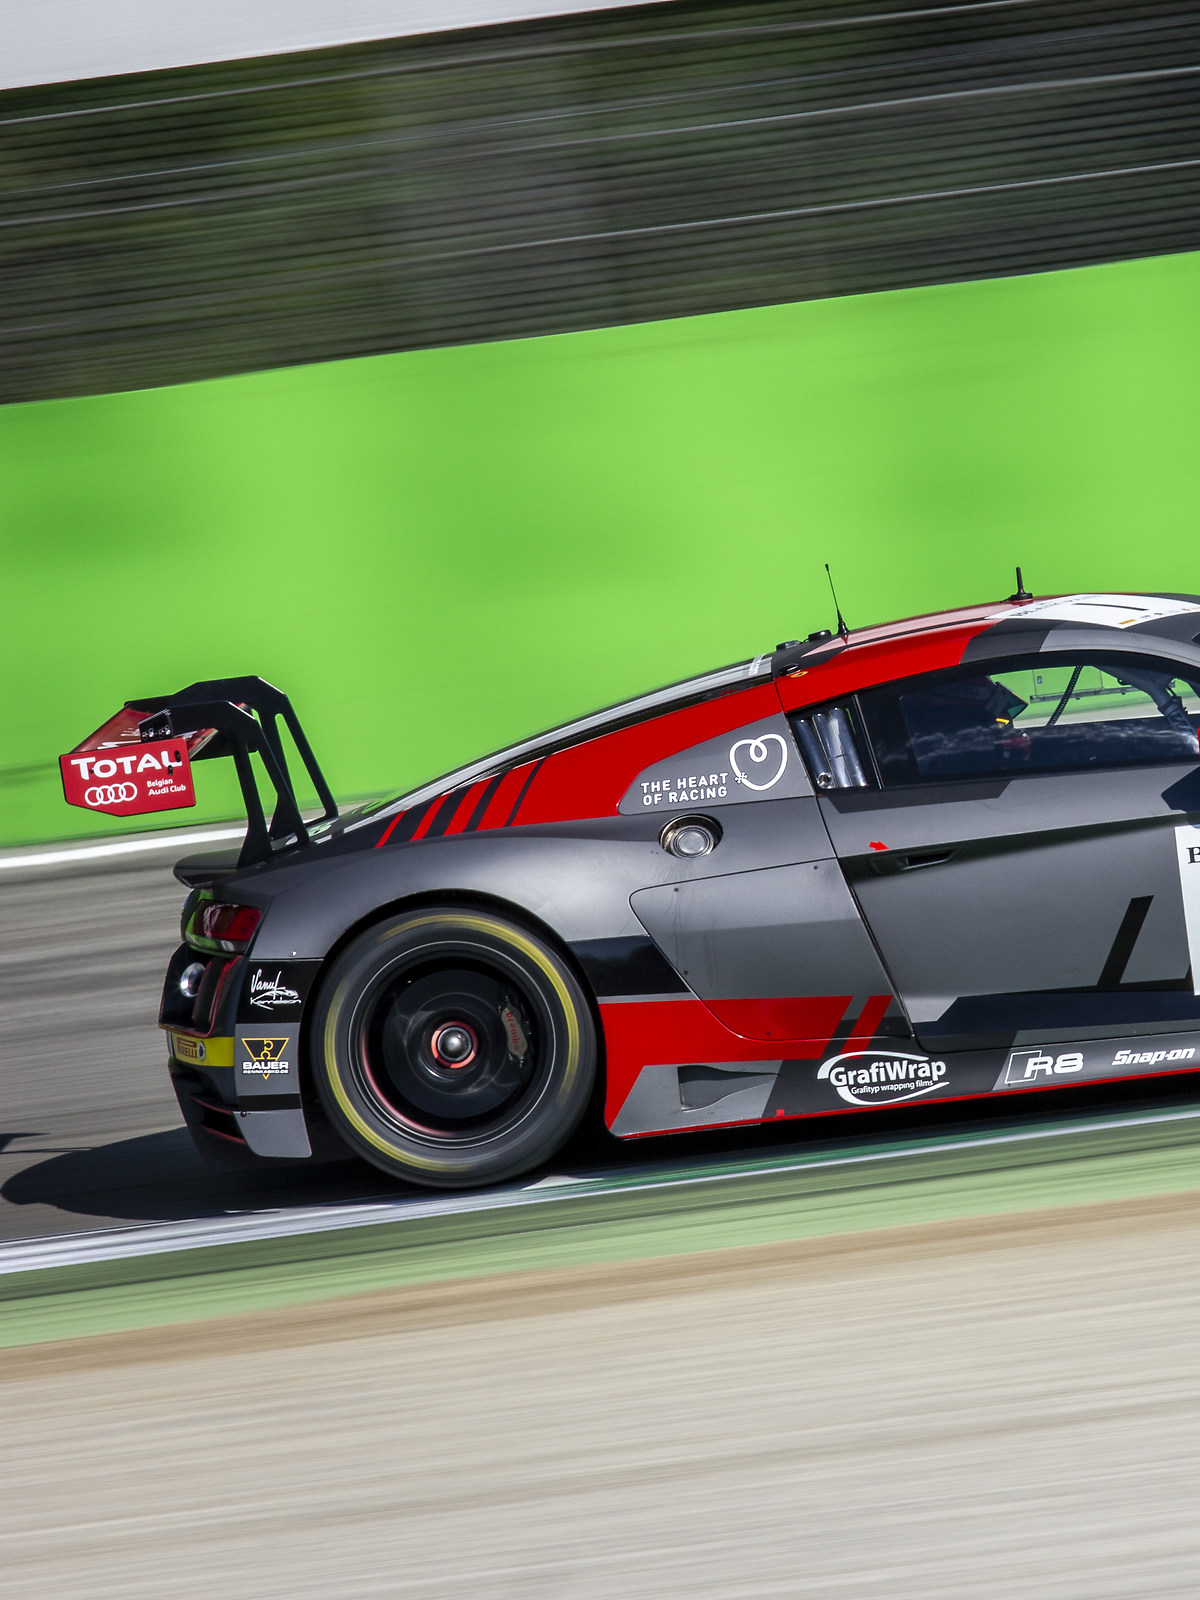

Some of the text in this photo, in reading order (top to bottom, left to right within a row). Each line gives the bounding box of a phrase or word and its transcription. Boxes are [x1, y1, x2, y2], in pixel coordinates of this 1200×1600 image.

[71, 750, 182, 780] TOTAL
[147, 778, 173, 788] Belgian
[148, 784, 186, 796] Audi Club
[641, 772, 729, 793] THE HEART
[643, 786, 728, 806] OF RACING
[177, 1037, 198, 1059] PIRELLI
[1111, 1048, 1196, 1066] Snap-on
[243, 1061, 289, 1070] BAUER
[829, 1060, 946, 1087] GrafiWrap
[1023, 1053, 1084, 1078] R8
[851, 1079, 934, 1095] Grafityp wrapping films
